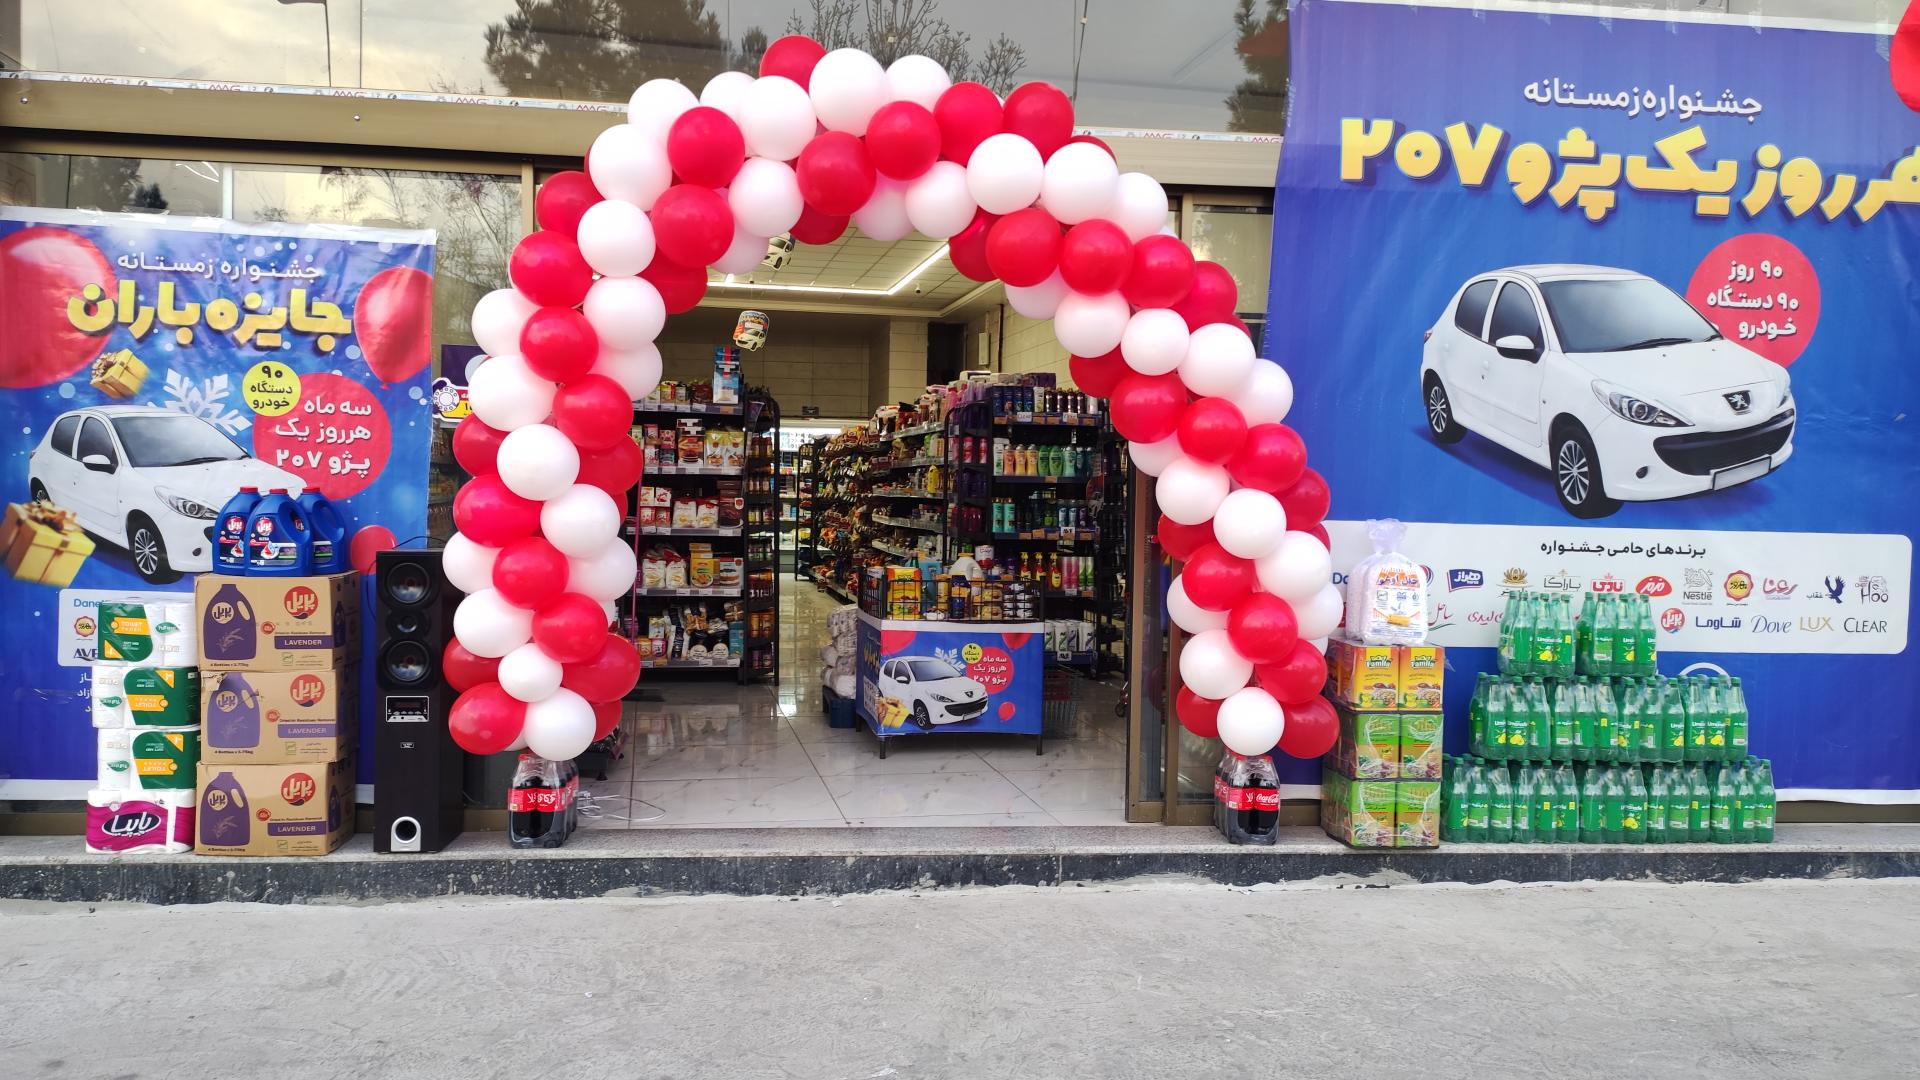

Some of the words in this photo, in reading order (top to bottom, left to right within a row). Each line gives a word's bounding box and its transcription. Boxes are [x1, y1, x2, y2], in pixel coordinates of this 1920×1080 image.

[1523, 77, 1641, 116] زمستانه
[1641, 86, 1763, 122] جشنواره
[1340, 118, 1504, 186] ۲۰۷
[1506, 127, 1622, 221] پژو
[117, 252, 215, 280] زمستانه
[220, 253, 322, 284] جشنواره
[1727, 260, 1756, 283] روز
[1760, 260, 1783, 279] ۹۰
[1706, 288, 1774, 311] دستگاه
[1776, 293, 1799, 310] ۹۰
[66, 279, 201, 346] باران
[204, 288, 353, 352] جایزه
[1738, 316, 1797, 341] خودرو
[261, 365, 284, 379] ۹۰
[249, 381, 294, 396] دستگاه
[252, 396, 290, 411] خودرو
[303, 396, 336, 415] ماه
[339, 400, 372, 416] سه
[275, 415, 311, 439] یک
[275, 450, 323, 470] ۲۰۷
[328, 454, 372, 479] پژو
[1541, 540, 1605, 556] جشنواره
[1608, 542, 1643, 557] حامی
[1646, 543, 1707, 559] برندهای
[1763, 578, 1799, 595] رعنا
[1695, 616, 1742, 630] شاوما
[1751, 615, 1792, 634] Dove
[1799, 616, 1835, 632] LUX
[1843, 617, 1888, 633] CLEAR
[277, 825, 316, 833] LAVENDER
